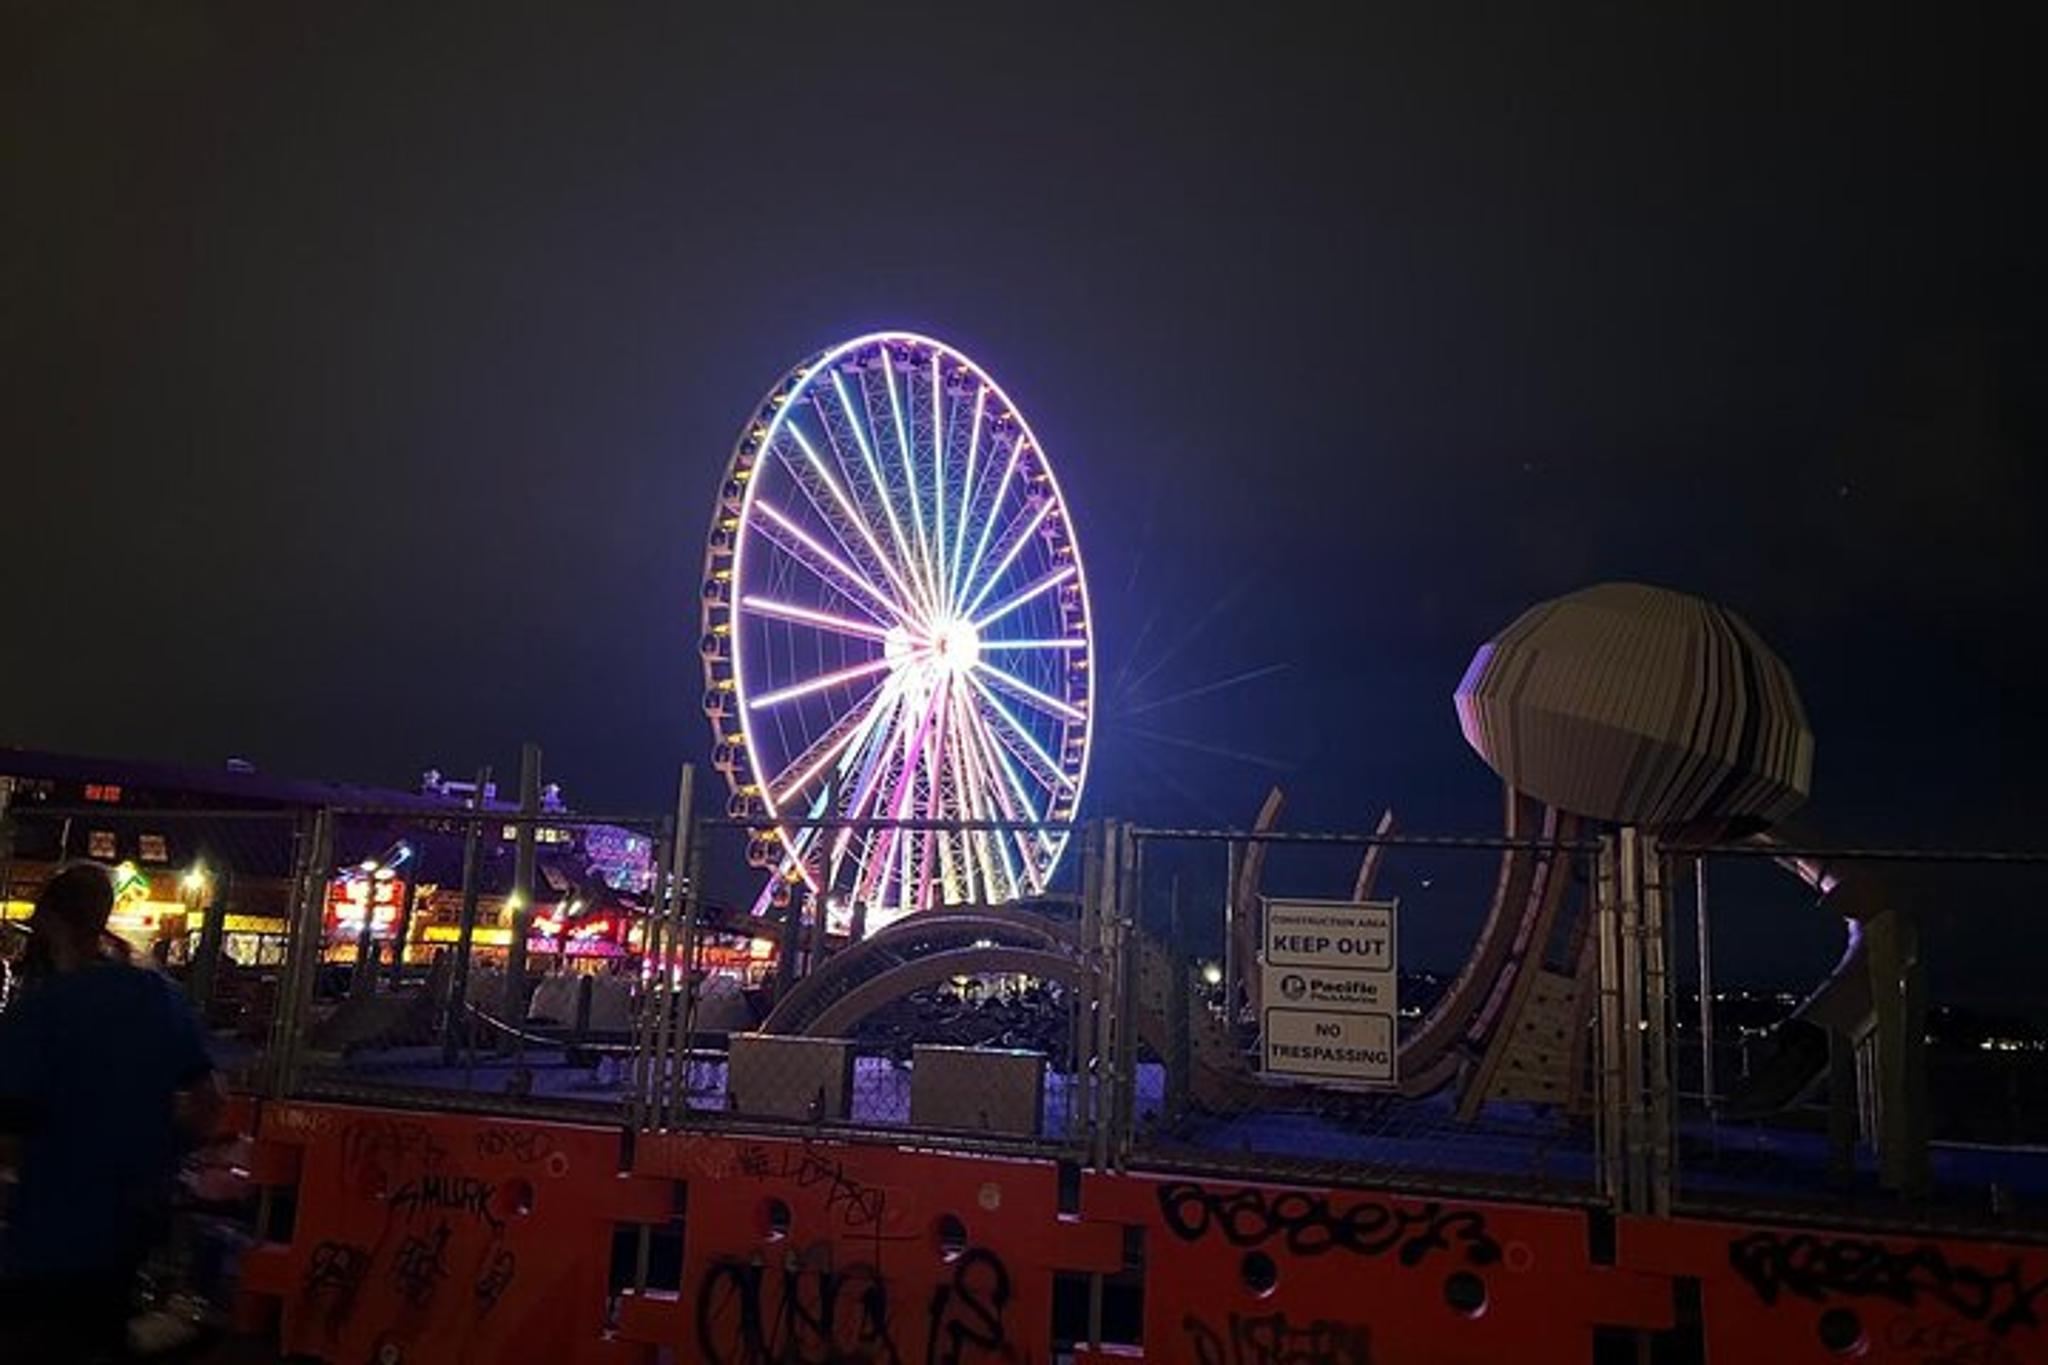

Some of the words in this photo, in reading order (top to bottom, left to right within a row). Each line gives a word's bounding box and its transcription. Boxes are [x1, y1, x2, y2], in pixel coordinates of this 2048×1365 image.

[1273, 934, 1330, 953] KEEP
[1337, 937, 1386, 956] OUT
[1311, 979, 1378, 995] Pacific
[1316, 1022, 1341, 1039] NO
[1271, 1042, 1389, 1065] TRESPASSING
